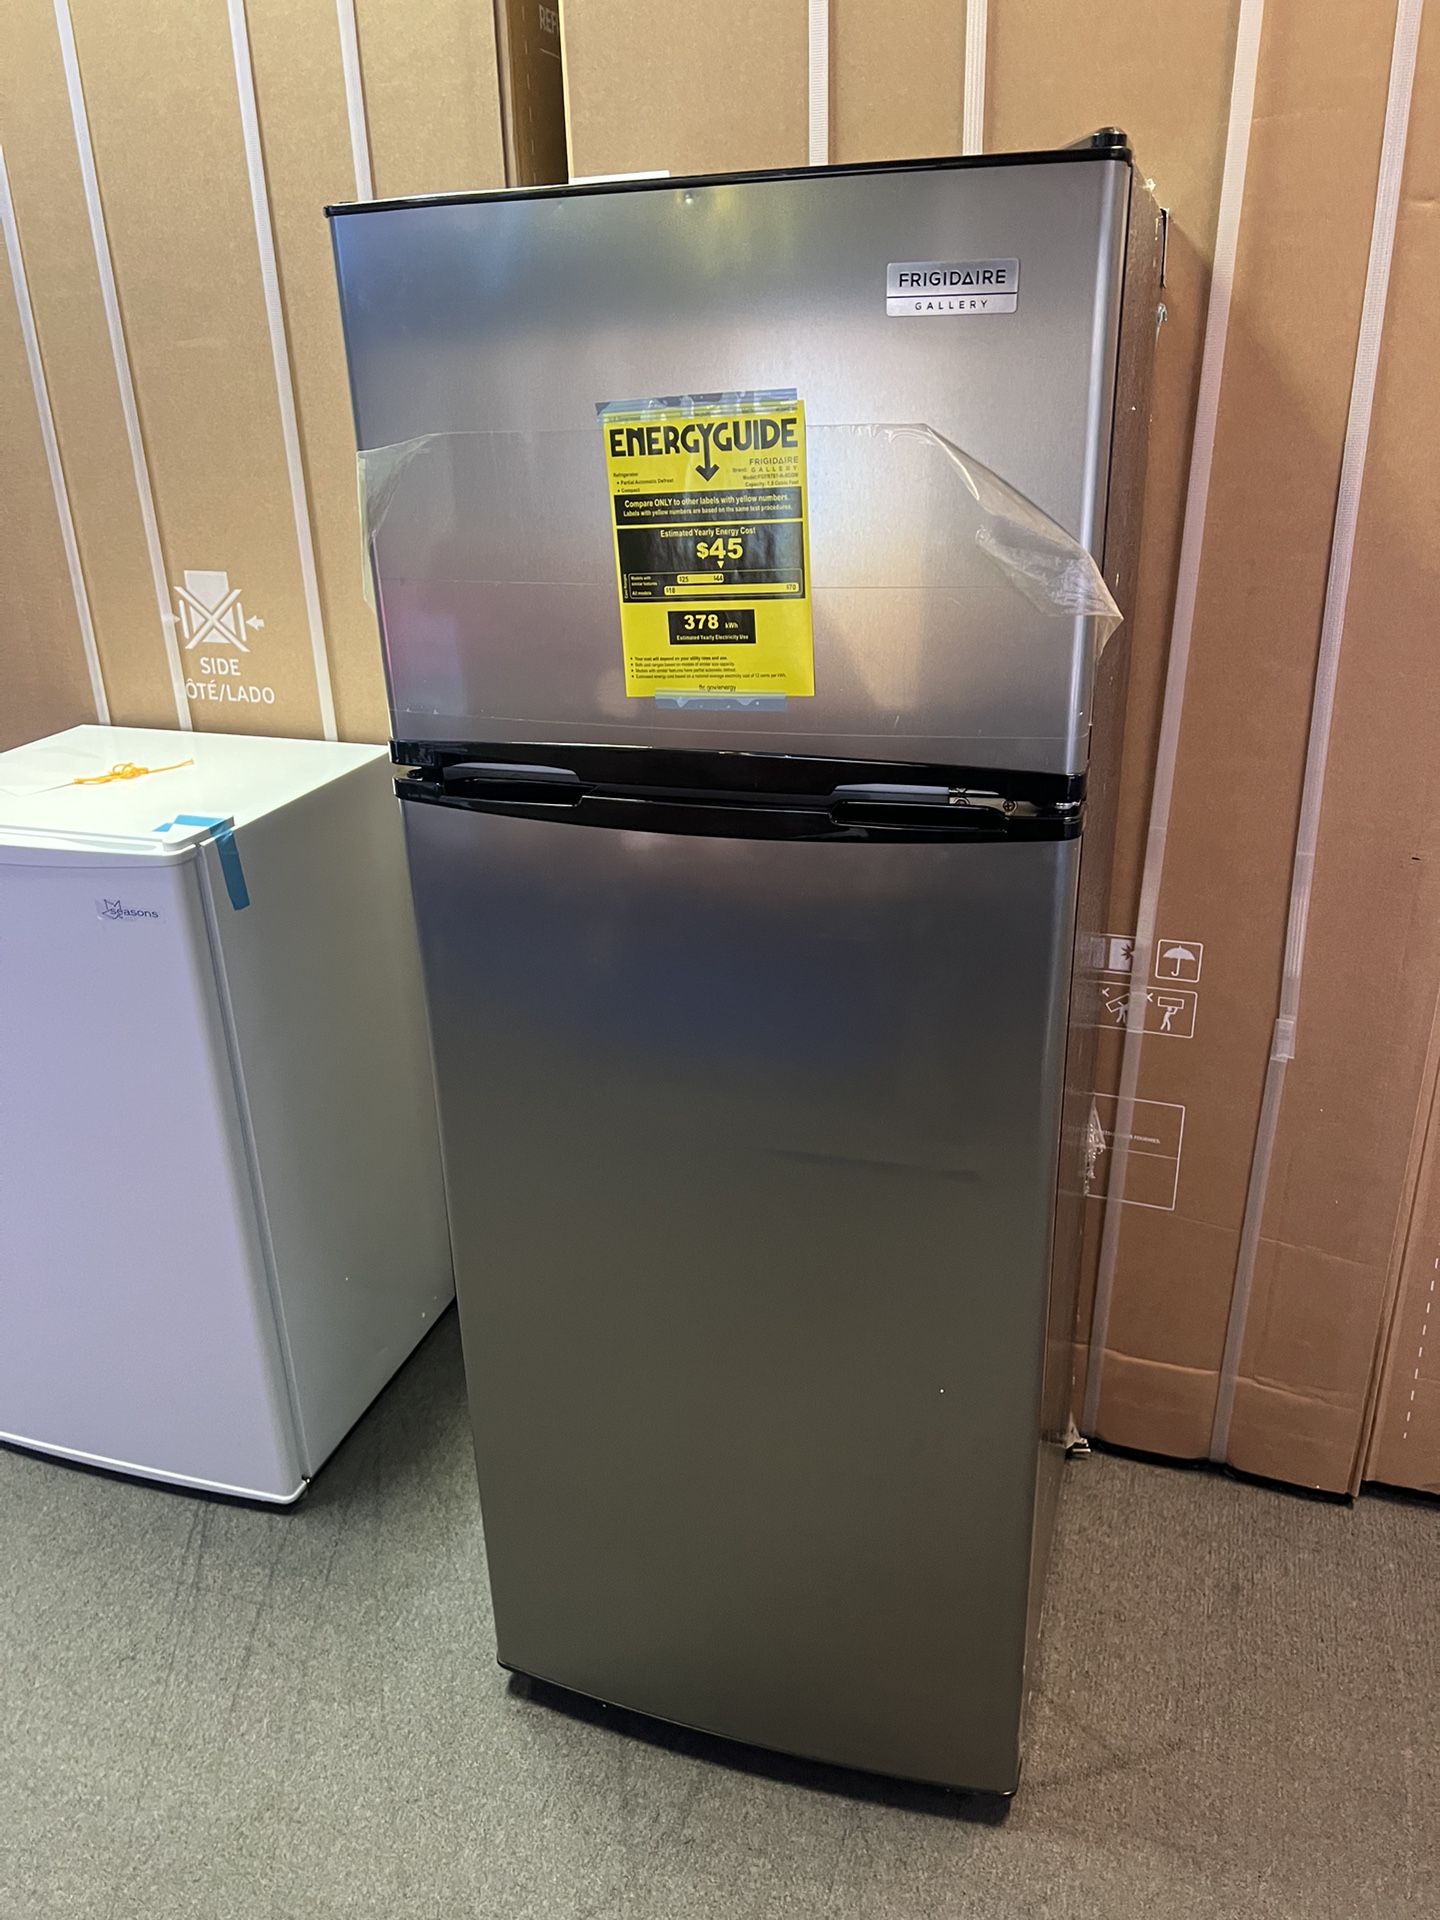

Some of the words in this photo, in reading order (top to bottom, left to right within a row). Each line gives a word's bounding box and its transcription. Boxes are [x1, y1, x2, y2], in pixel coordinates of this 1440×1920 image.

[899, 269, 1006, 288] FRIGIDAIRE
[915, 300, 988, 310] GALLERY
[609, 418, 798, 457] ENERGYGUIDE
[749, 456, 799, 465] FRIGIDAIRE
[624, 500, 653, 509] Compare
[654, 498, 672, 507] ONLY
[681, 497, 698, 505] other
[699, 496, 720, 504] labels
[736, 494, 757, 504] yellow
[652, 509, 669, 517] yellow
[701, 506, 718, 514] based
[660, 528, 694, 538] Estimated
[694, 528, 714, 538] Yearly
[715, 528, 739, 537] Energy
[740, 527, 756, 535] Cost
[696, 538, 744, 560] $45
[684, 614, 719, 630] 378
[200, 656, 241, 676] SIDE
[185, 678, 275, 704] ÔTÉ/LADO
[110, 908, 159, 918] seasons
